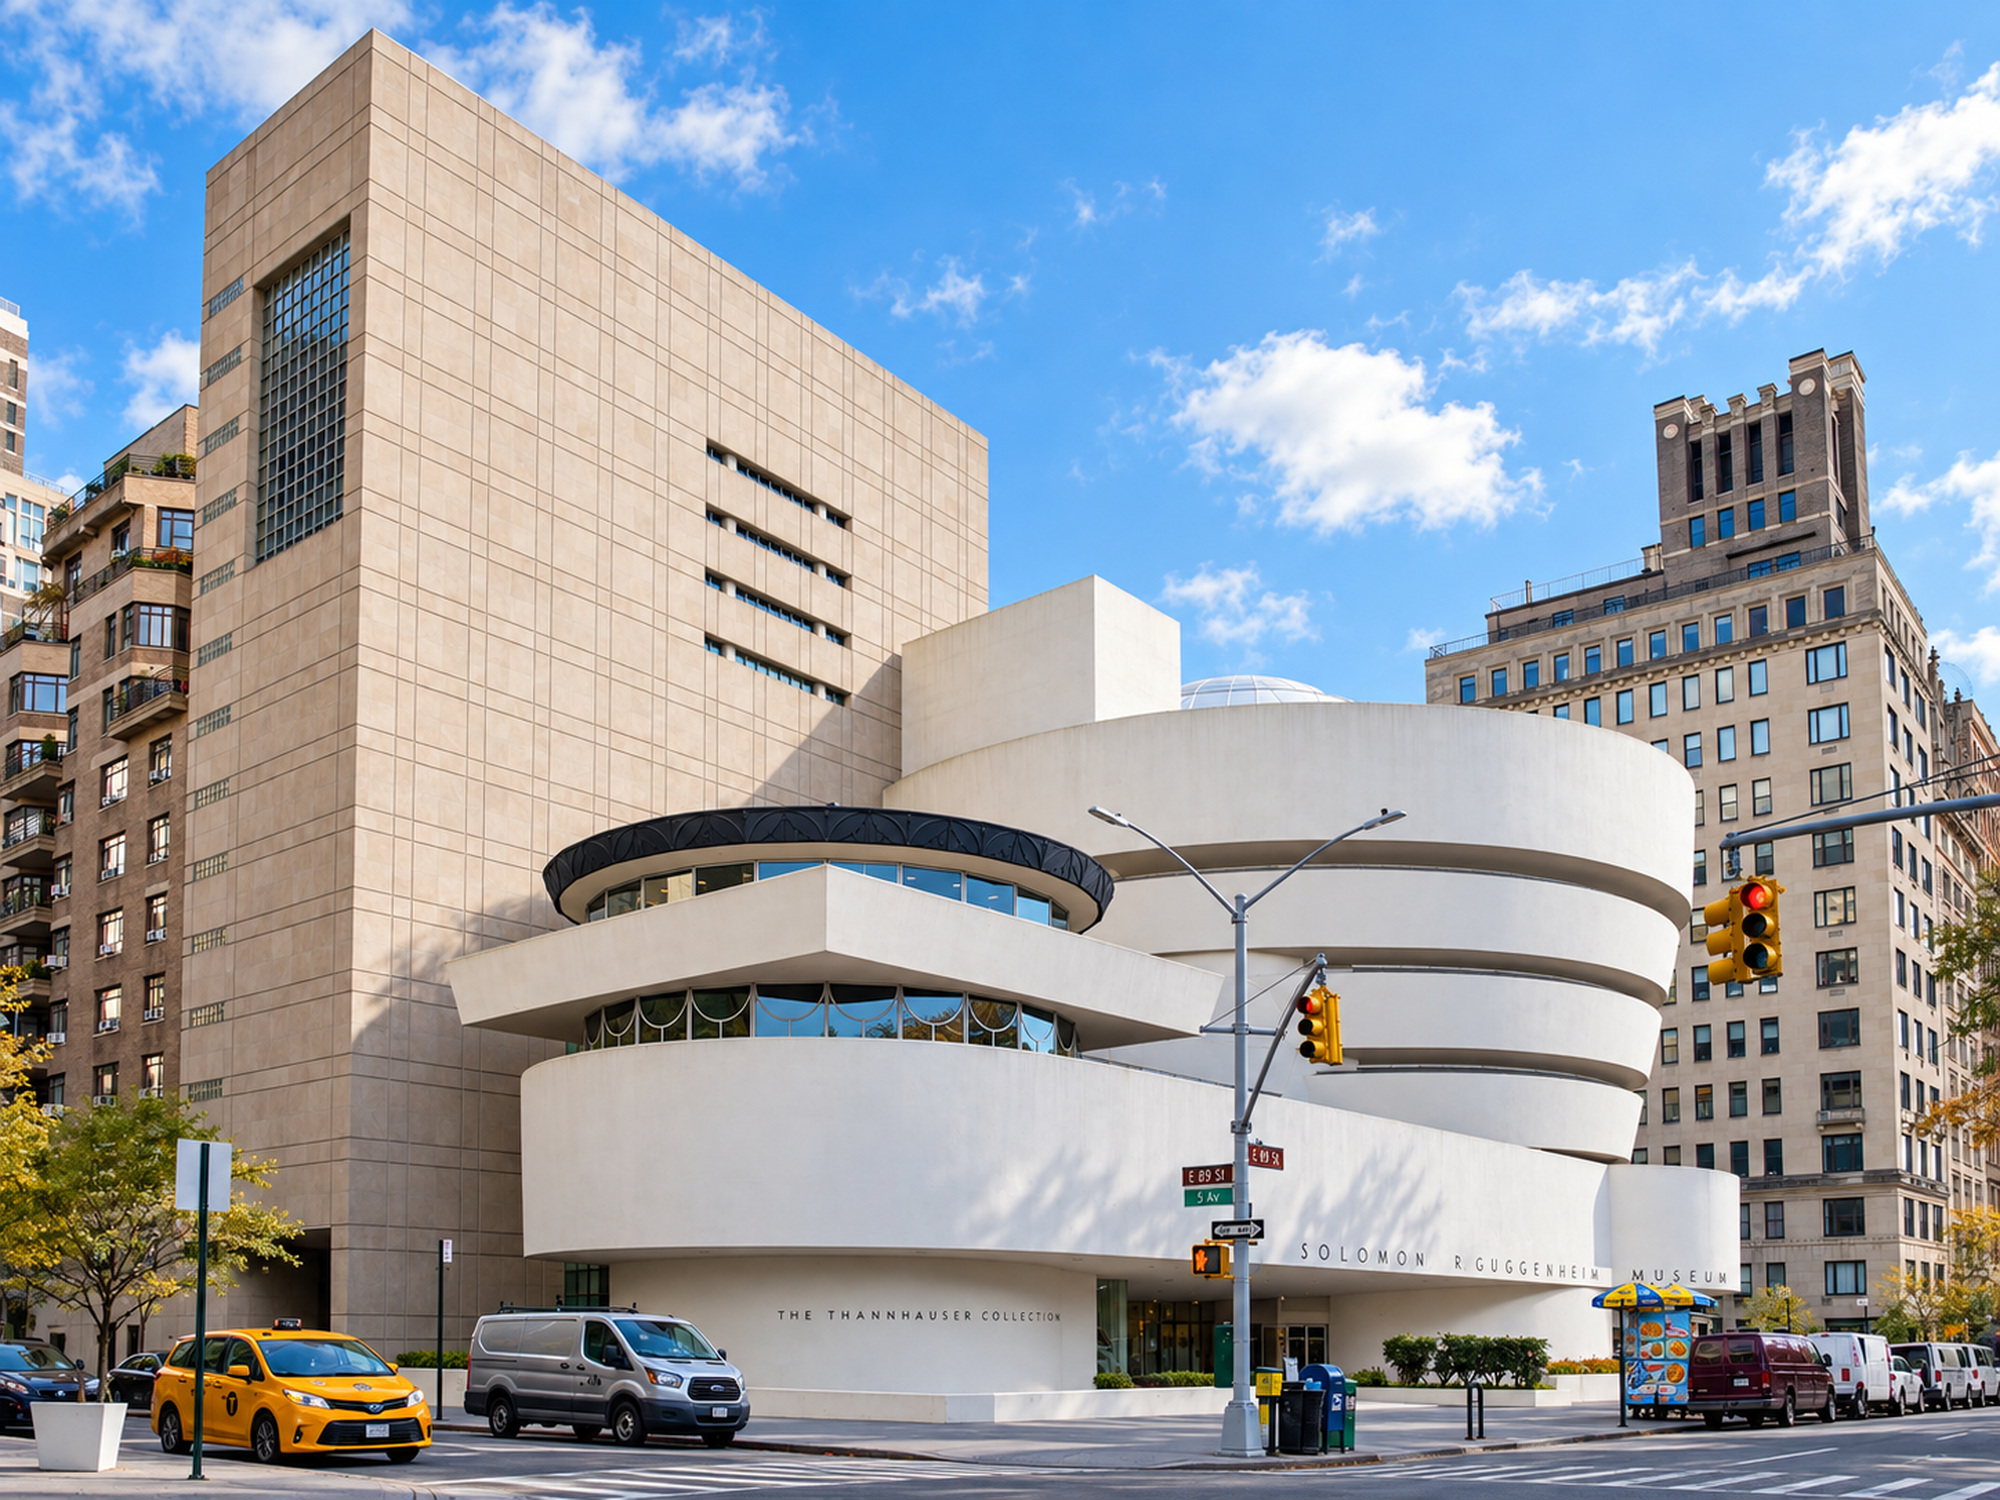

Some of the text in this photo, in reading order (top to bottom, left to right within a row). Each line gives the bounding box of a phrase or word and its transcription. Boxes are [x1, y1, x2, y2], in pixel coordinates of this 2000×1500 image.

[1189, 1170, 1194, 1183] E
[1300, 1242, 1424, 1266] SOLOMON
[1475, 1257, 1599, 1281] GUGGENHEIM
[1631, 1269, 1727, 1284] MUSEUM
[777, 1310, 1061, 1321] THE THANNHAUSER COLLECTION
